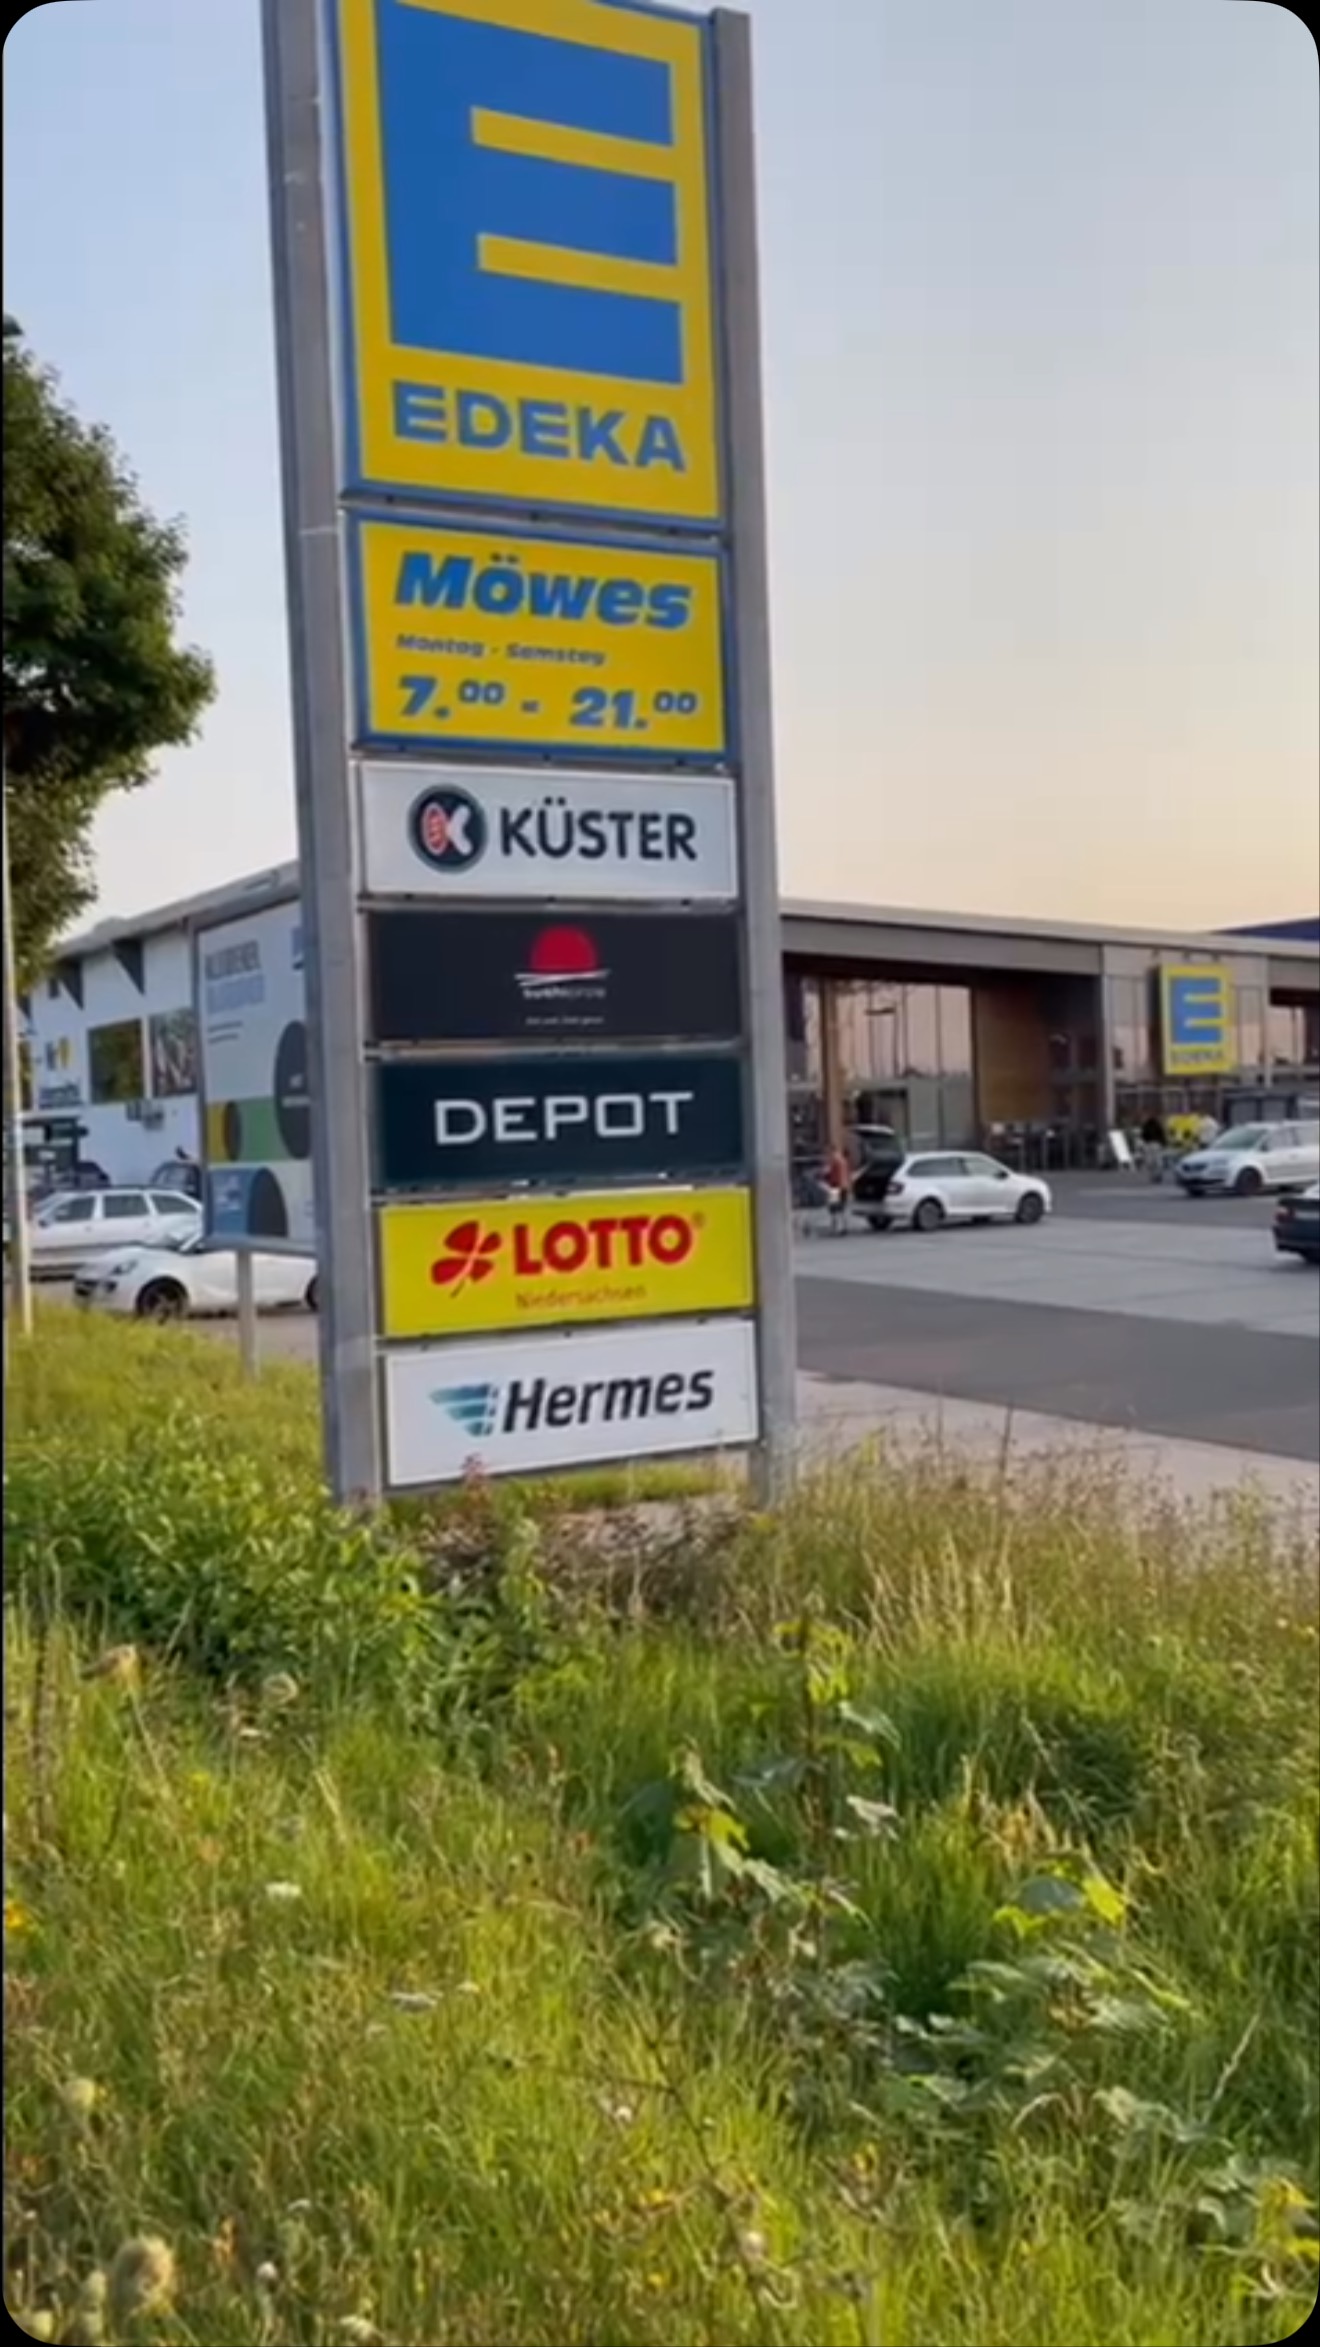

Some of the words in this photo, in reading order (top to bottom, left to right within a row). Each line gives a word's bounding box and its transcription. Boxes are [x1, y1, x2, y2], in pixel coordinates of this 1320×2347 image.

[391, 379, 687, 473] EDEKA
[394, 551, 692, 630] Möwes
[396, 633, 484, 658] Montag
[506, 641, 607, 667] Samstag
[500, 796, 697, 861] KÜSTER
[434, 1091, 694, 1145] DEPOT
[516, 1284, 647, 1309] Niedersachsen
[502, 1369, 715, 1434] Hermes
